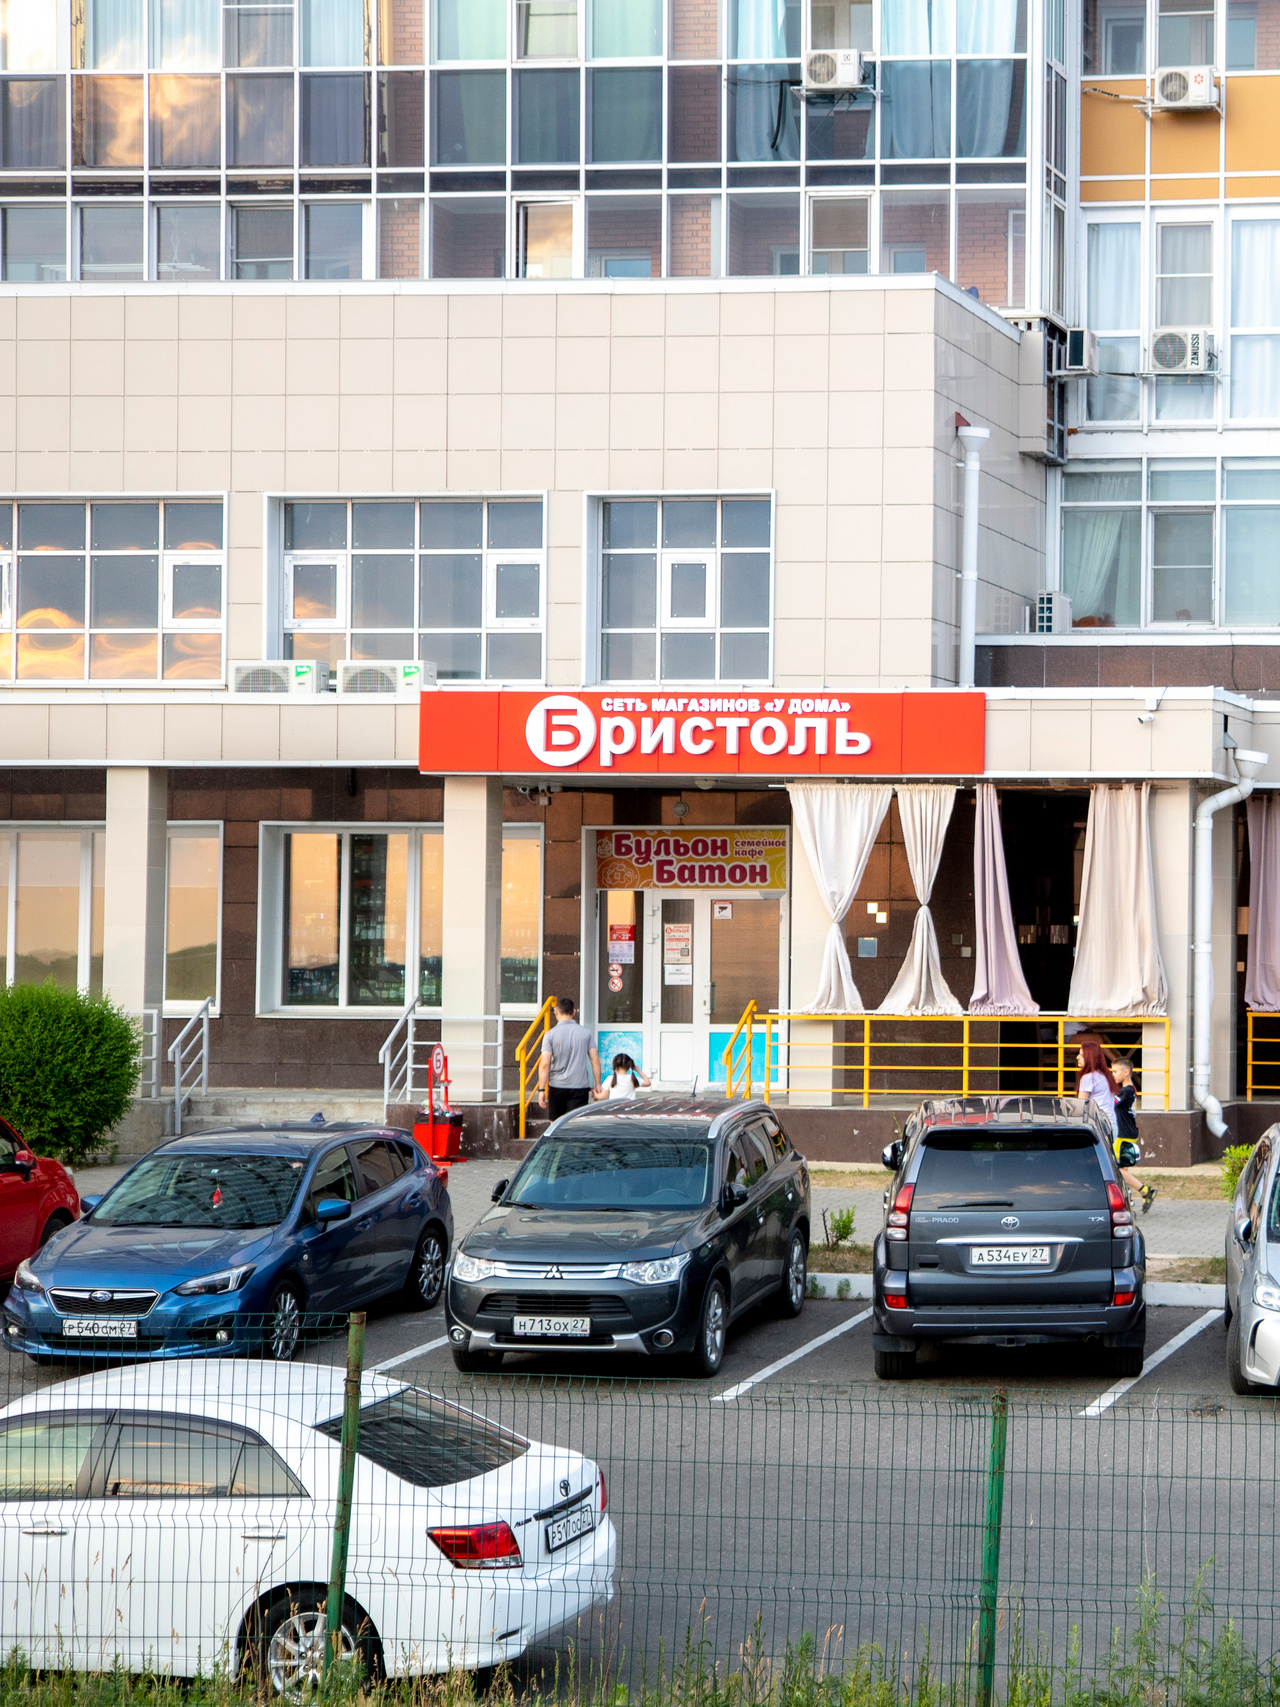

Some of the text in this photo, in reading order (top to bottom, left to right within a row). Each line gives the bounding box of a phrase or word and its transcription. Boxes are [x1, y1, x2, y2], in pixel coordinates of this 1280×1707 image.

[1191, 334, 1200, 366] ZANUSSI
[601, 698, 851, 714] СЕТЬ МАГАЗИНОВ «У ДОМА»
[613, 832, 729, 865] Бульон
[734, 848, 764, 858] кафе
[655, 859, 769, 884] Батон
[435, 1052, 441, 1070] Б
